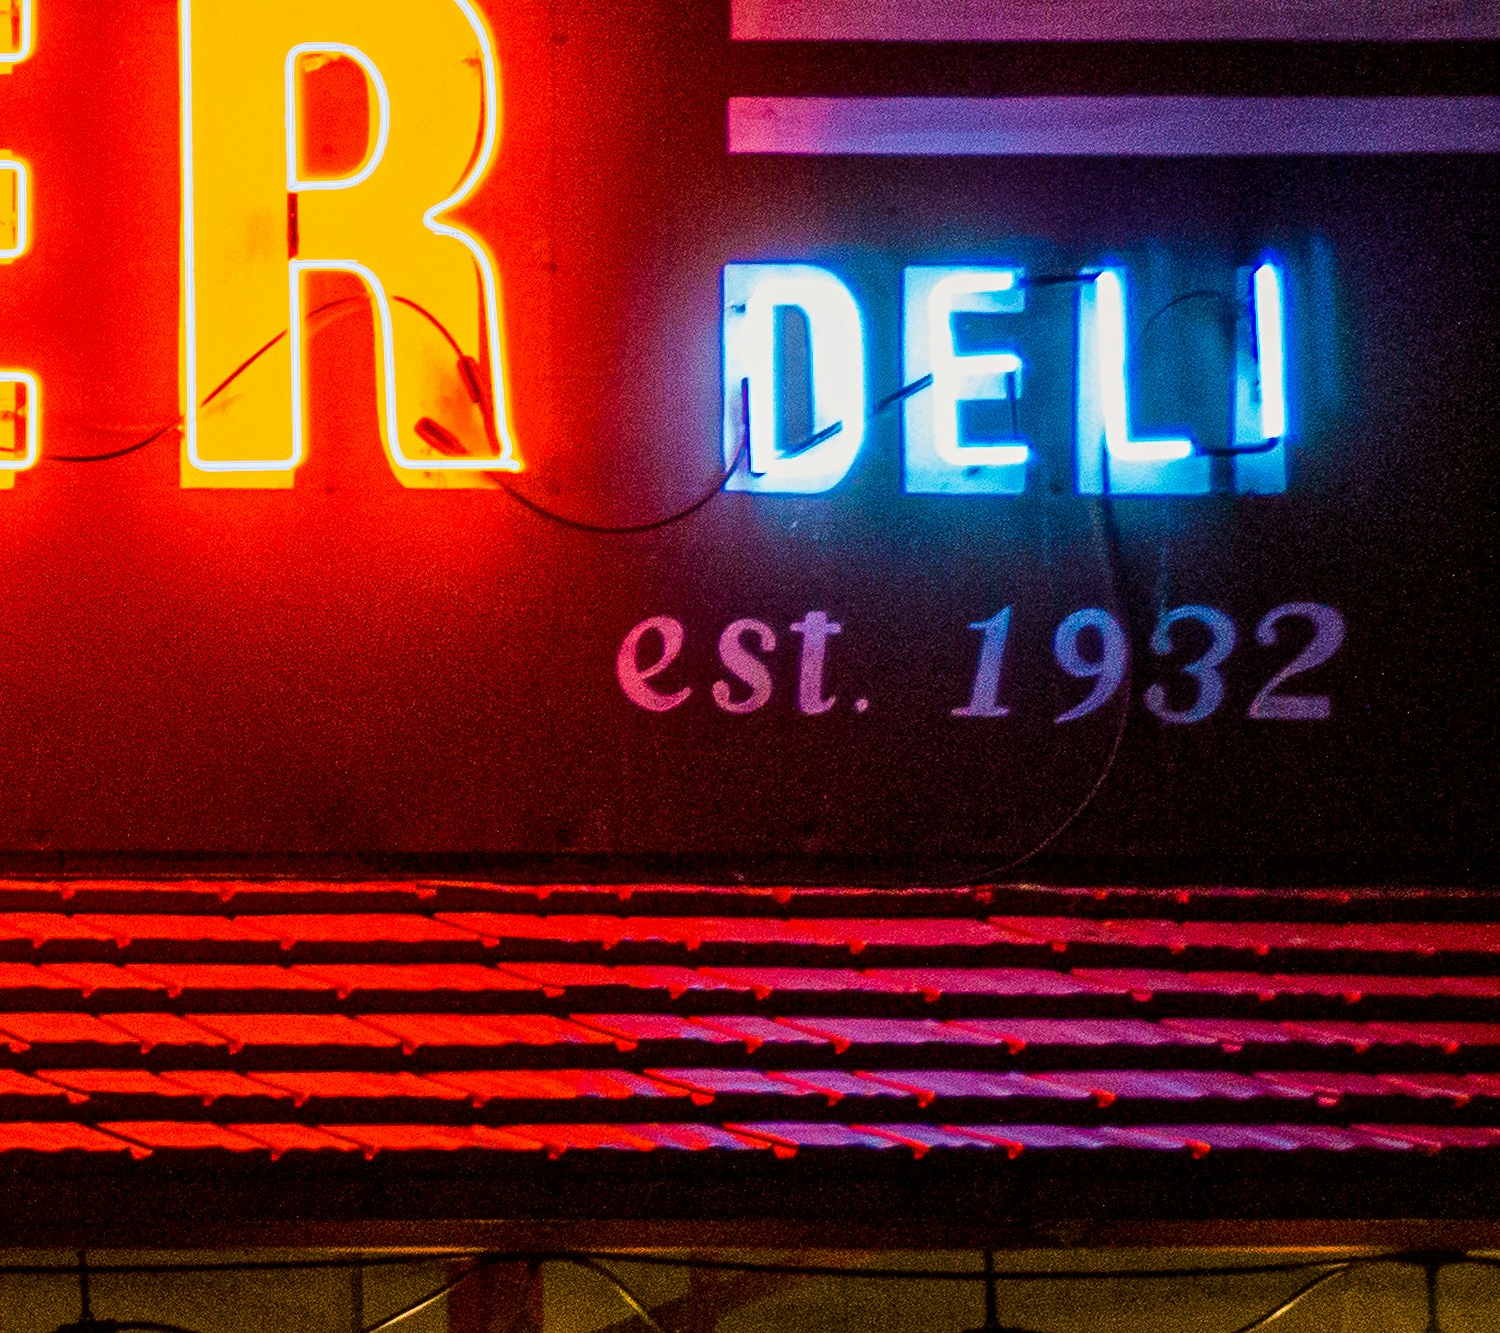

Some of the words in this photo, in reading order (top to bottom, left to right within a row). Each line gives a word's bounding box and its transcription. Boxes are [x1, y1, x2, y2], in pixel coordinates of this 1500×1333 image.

[722, 258, 1288, 494] DELI
[617, 609, 869, 714] est.
[952, 602, 1348, 725] 1932
